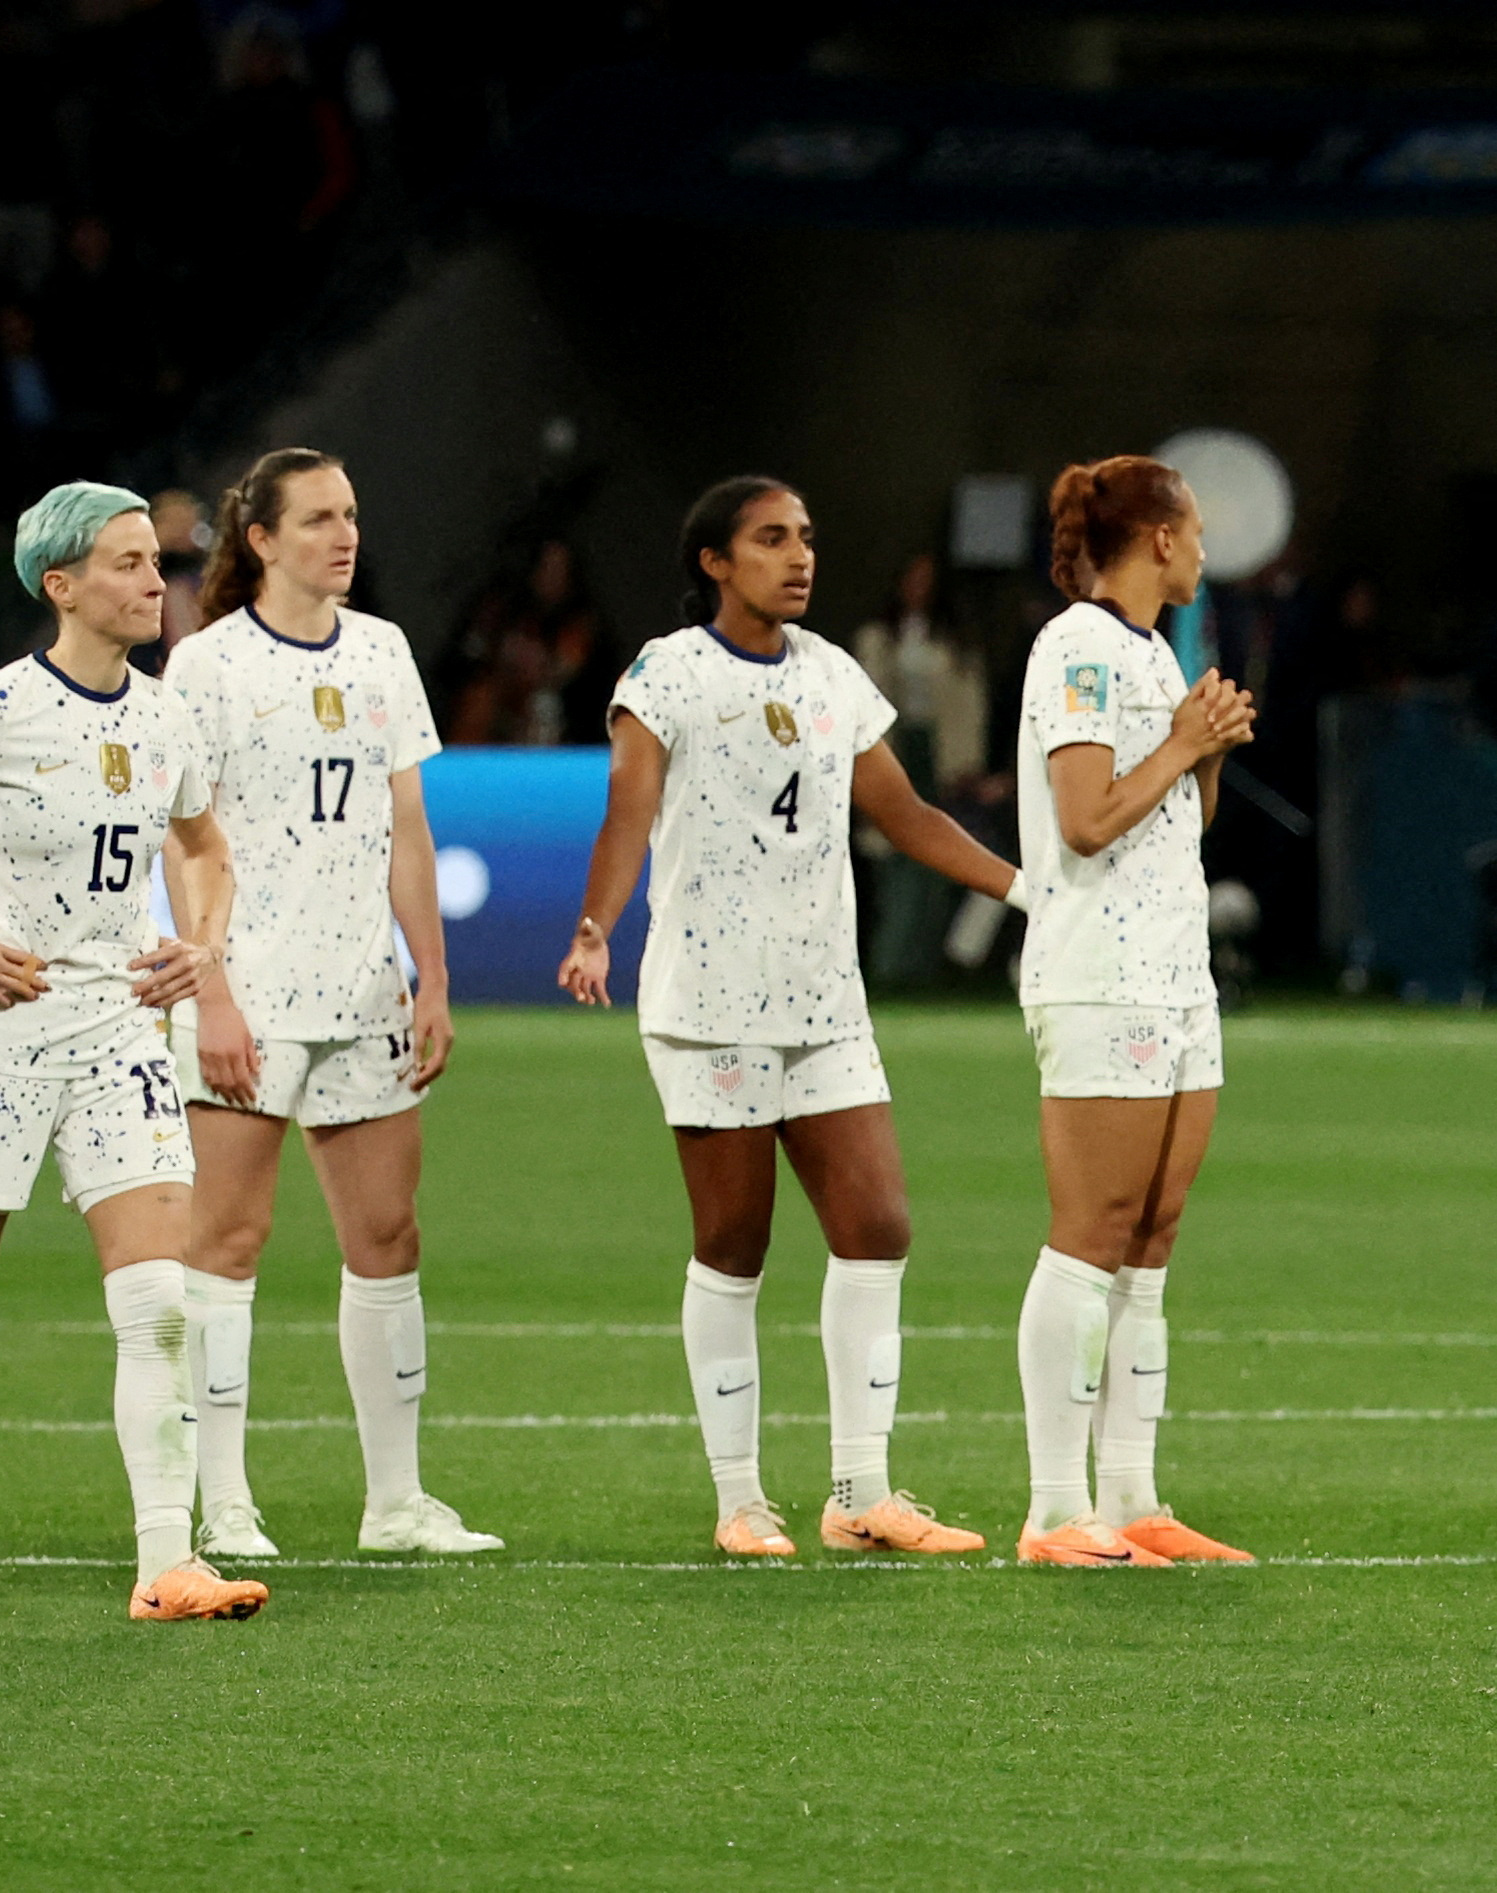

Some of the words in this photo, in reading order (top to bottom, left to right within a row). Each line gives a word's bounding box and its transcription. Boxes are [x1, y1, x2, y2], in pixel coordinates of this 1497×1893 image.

[310, 757, 355, 822] 17
[771, 771, 799, 833] 4
[87, 823, 139, 892] 15
[710, 1053, 739, 1071] USA
[1128, 1026, 1155, 1043] USA
[129, 1059, 181, 1119] 15
